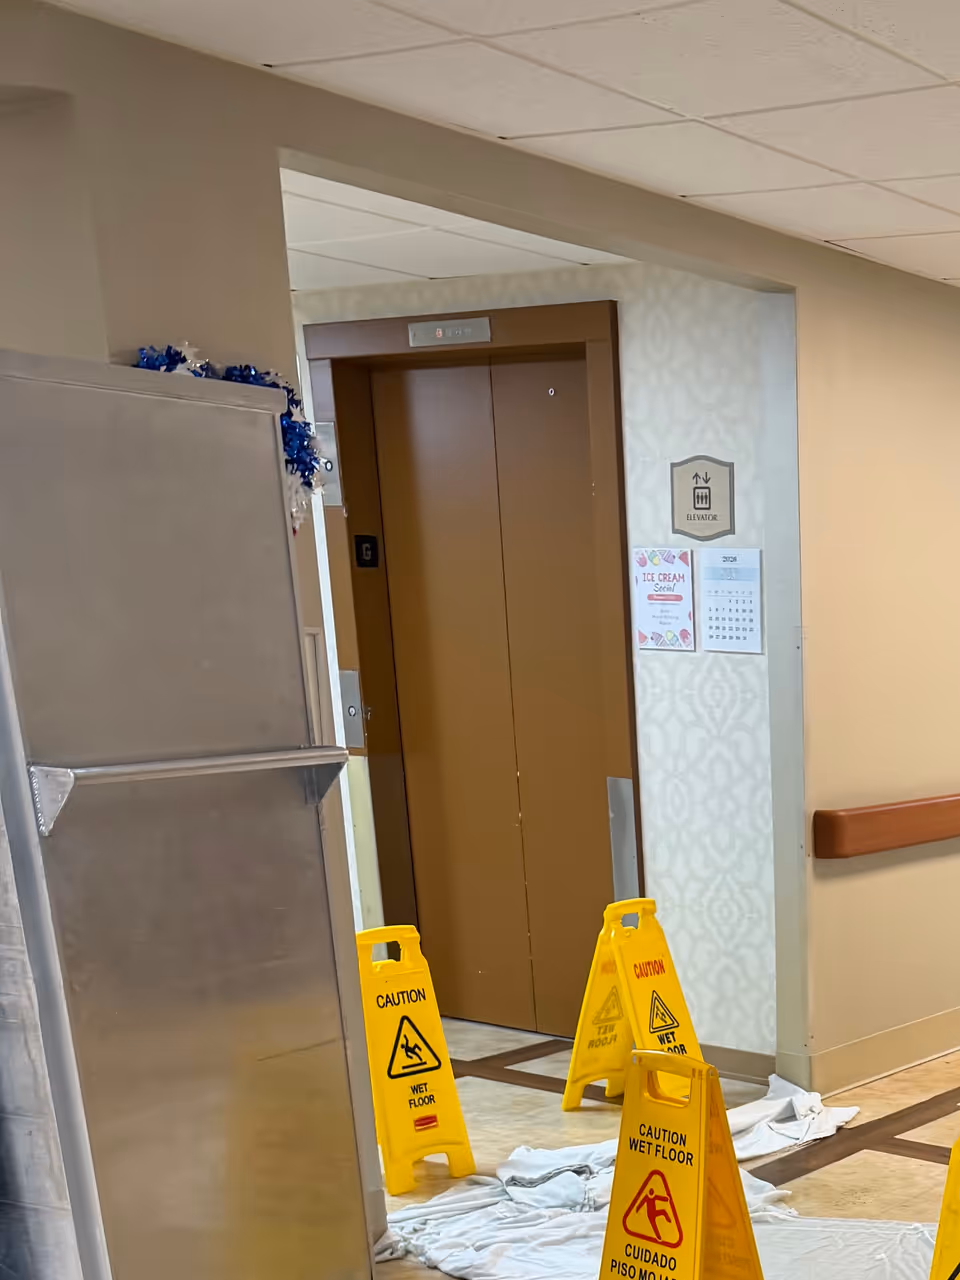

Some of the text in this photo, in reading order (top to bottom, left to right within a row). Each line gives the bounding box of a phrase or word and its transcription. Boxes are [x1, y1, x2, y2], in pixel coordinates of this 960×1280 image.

[686, 513, 718, 521] ELEVATOR
[362, 543, 371, 560] G
[642, 572, 685, 583] ICE CREAM
[653, 582, 677, 592] Social
[633, 959, 666, 980] CAUTION
[376, 988, 426, 1009] CAUTION
[656, 1031, 677, 1045] WET
[410, 1082, 428, 1095] WET
[408, 1094, 436, 1109] FLOOR
[639, 1123, 687, 1147] CAUTION
[629, 1137, 694, 1166] WET FLOOR
[624, 1243, 677, 1271] CUIDADO
[610, 1258, 636, 1279] PISO
